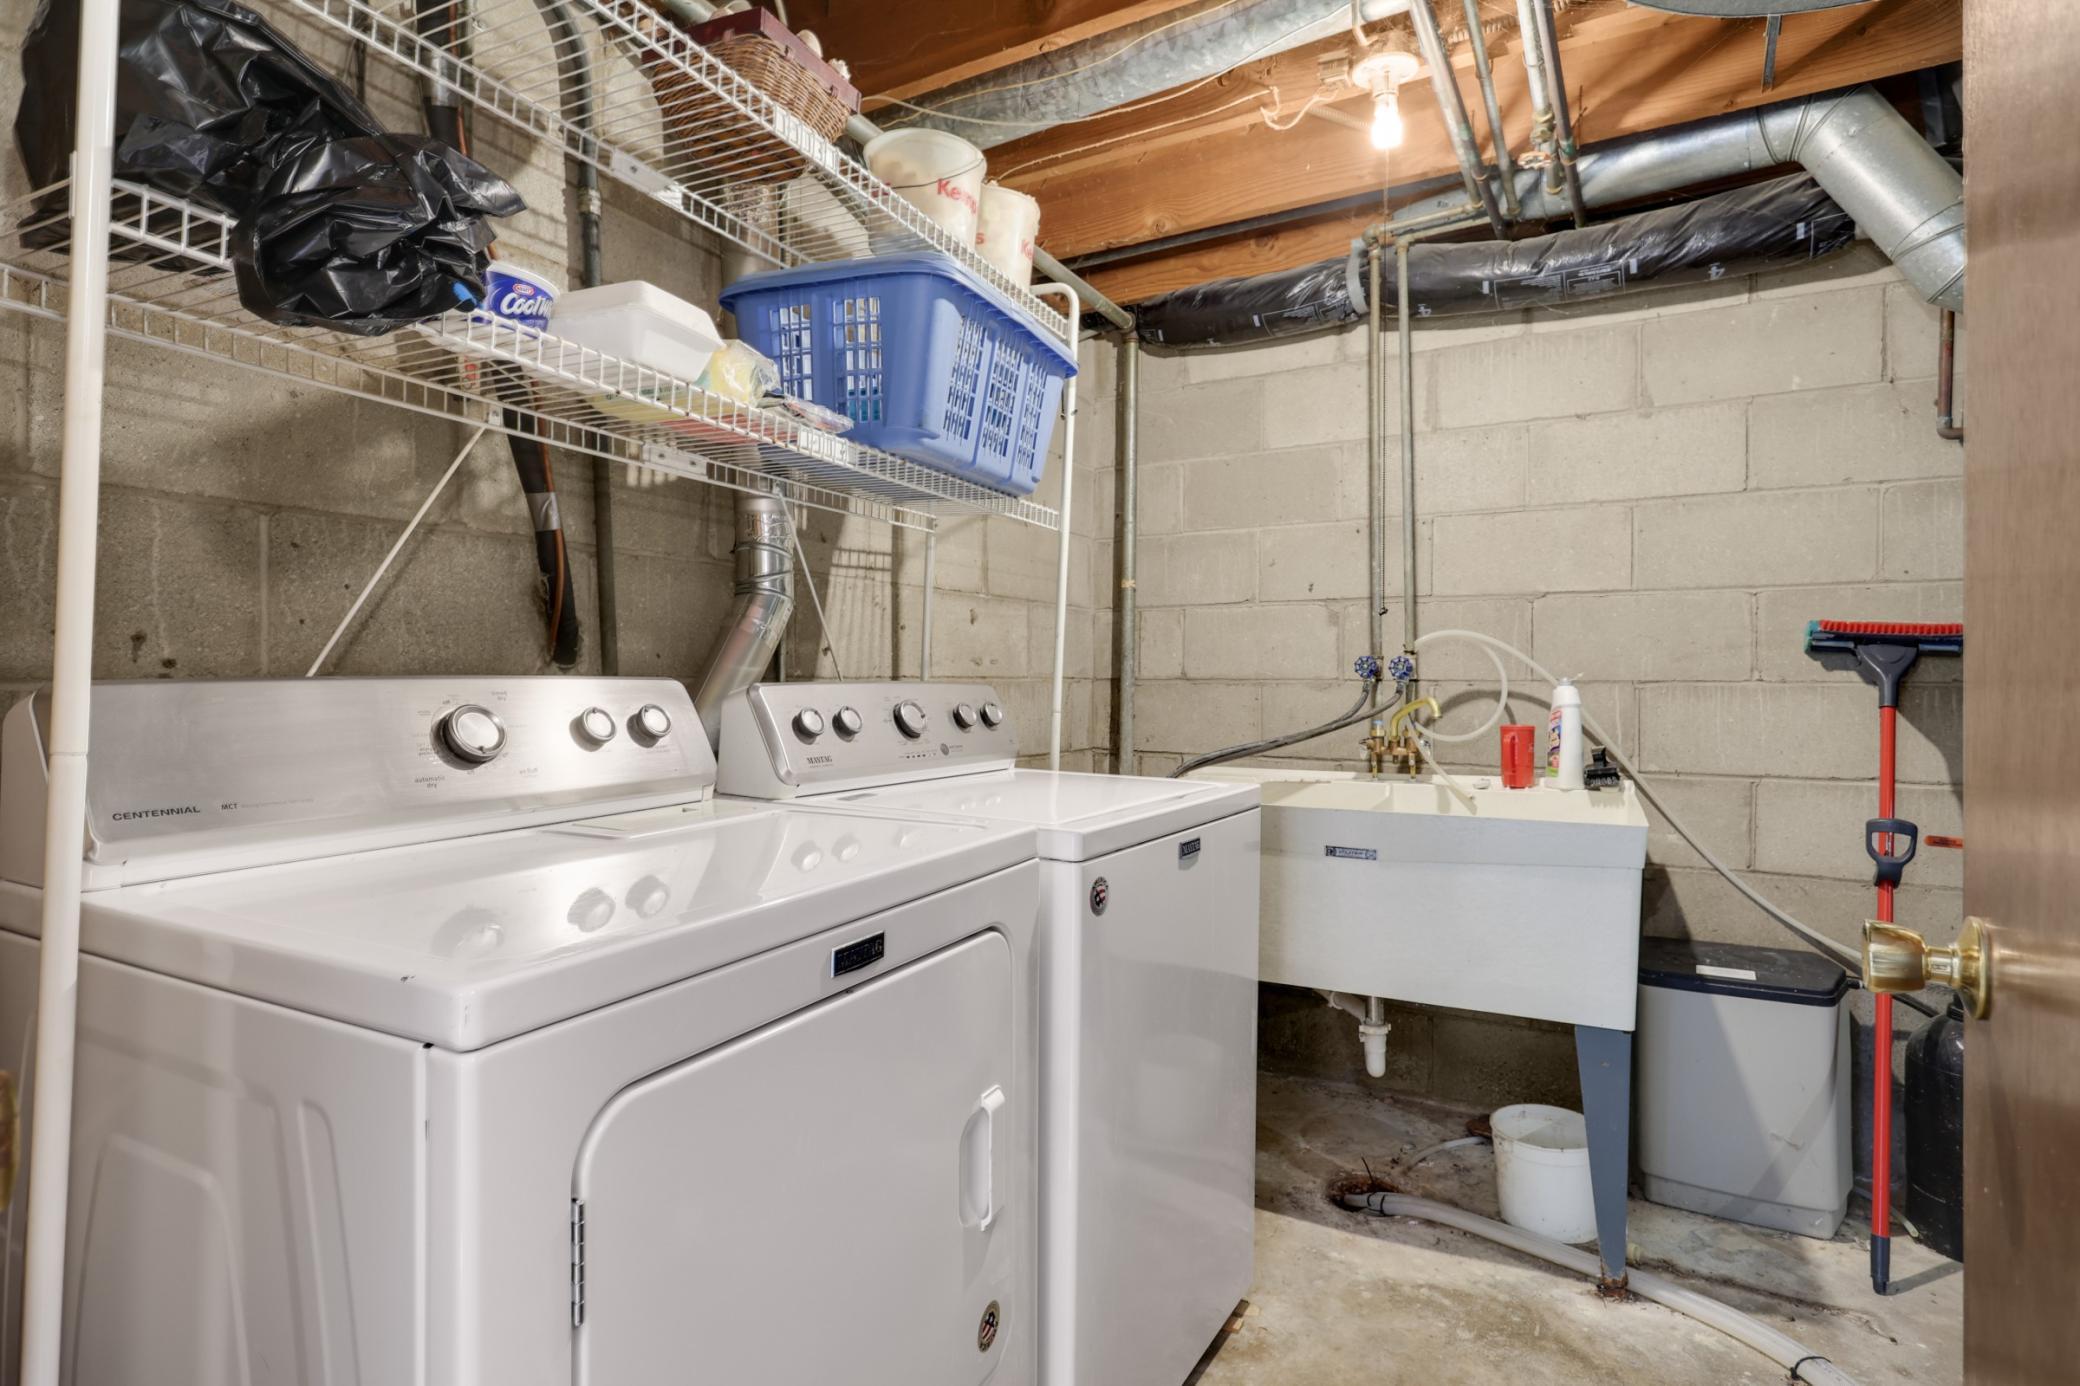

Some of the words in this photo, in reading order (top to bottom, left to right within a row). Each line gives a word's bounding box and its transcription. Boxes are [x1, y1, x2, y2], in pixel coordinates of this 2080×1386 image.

[500, 292, 545, 315] Cool
[112, 806, 200, 822] CENTENNIAL
[221, 802, 238, 811] MCT
